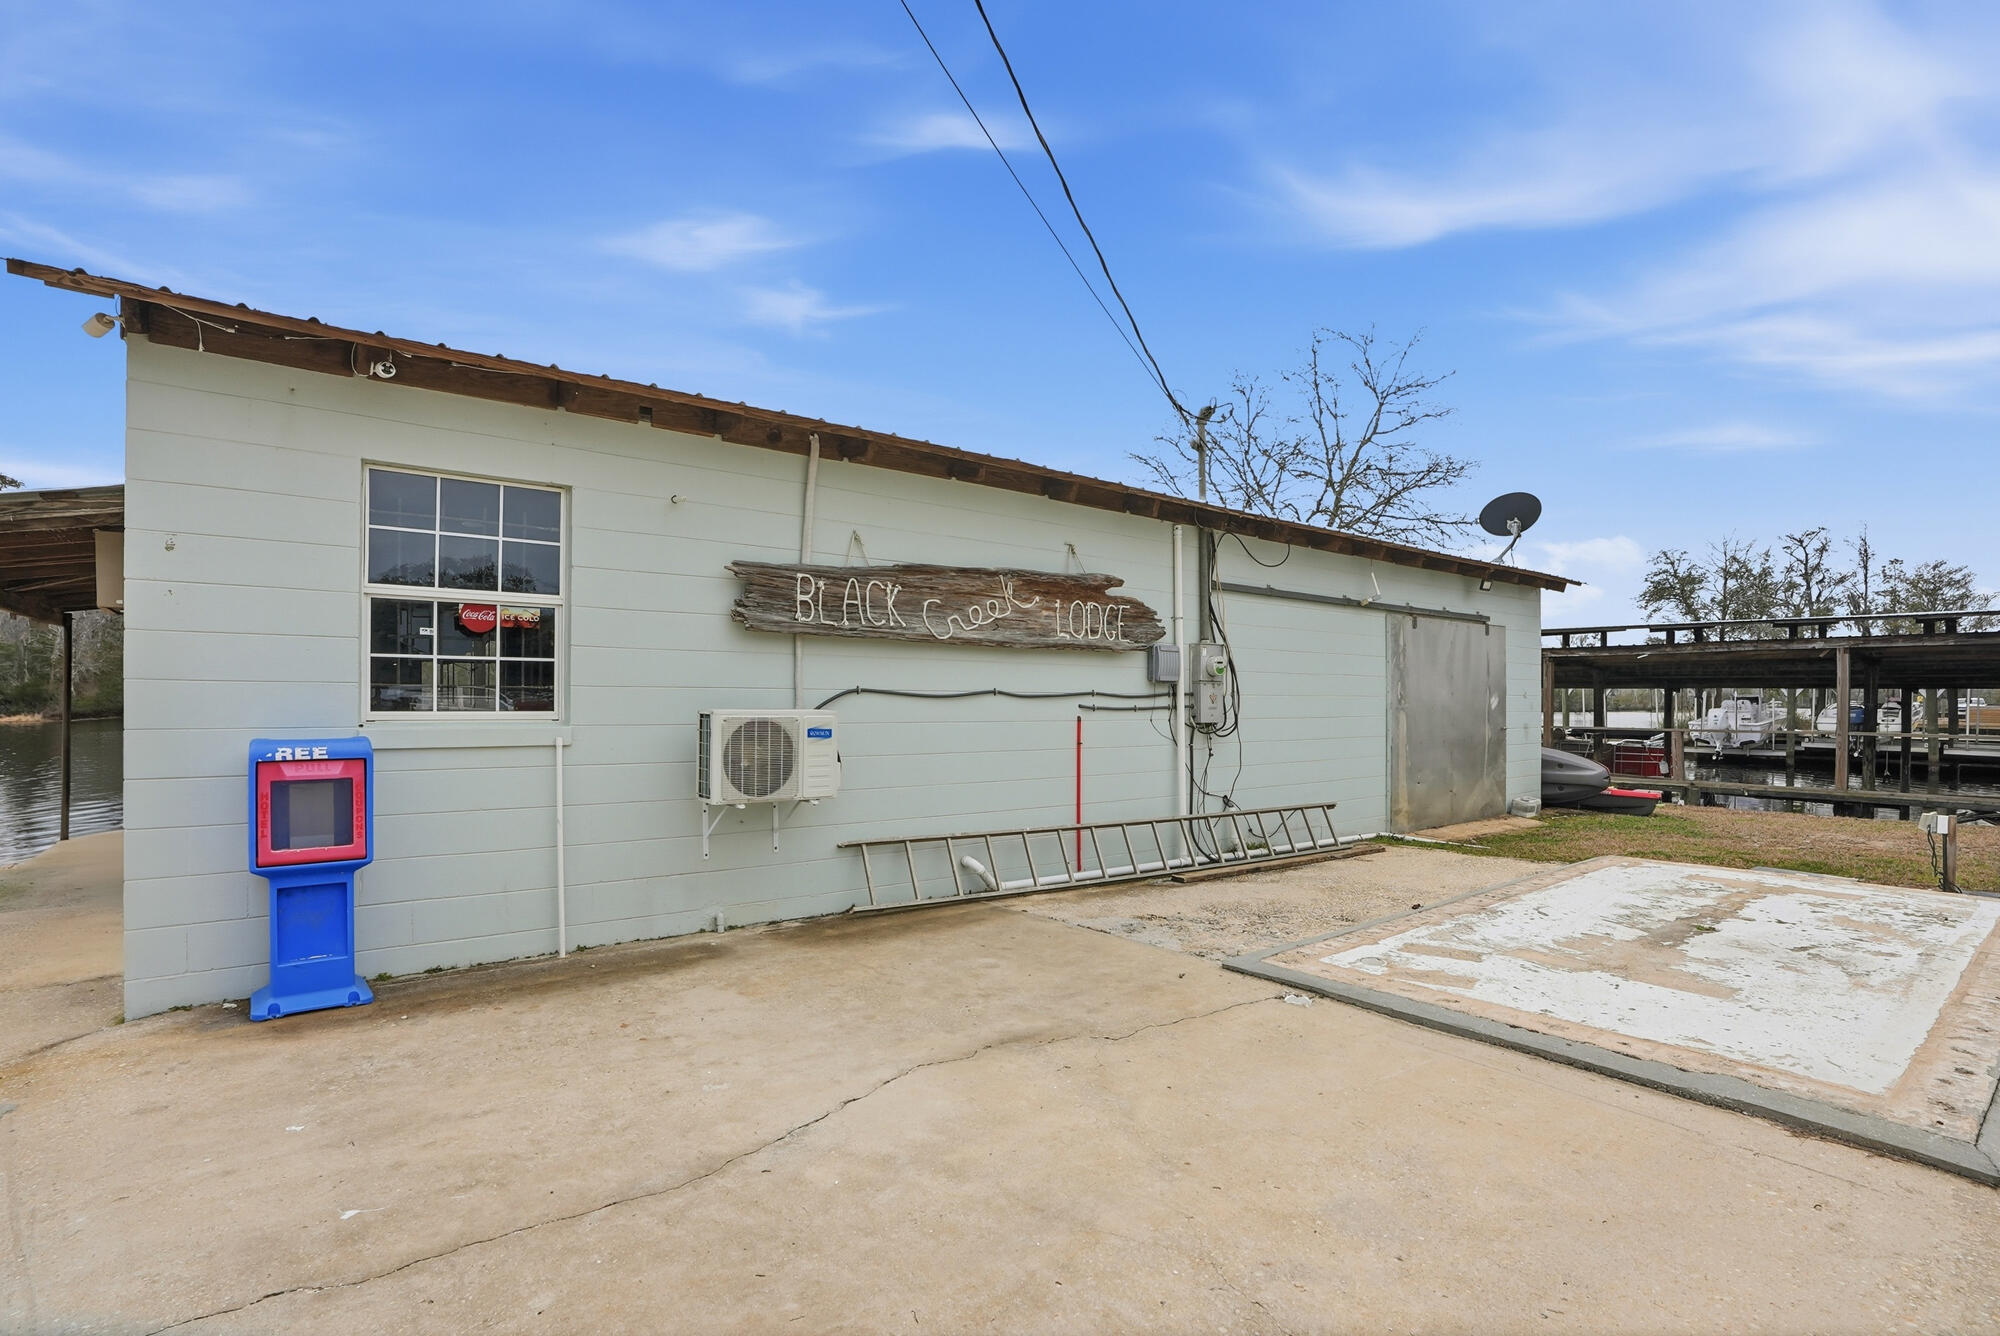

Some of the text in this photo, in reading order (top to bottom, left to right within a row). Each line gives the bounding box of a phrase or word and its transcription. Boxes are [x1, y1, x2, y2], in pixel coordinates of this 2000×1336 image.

[501, 613, 516, 621] ICE
[795, 573, 1130, 642] BLACK Creek LODGE
[266, 746, 329, 761] REE
[260, 791, 269, 839] HOTEL
